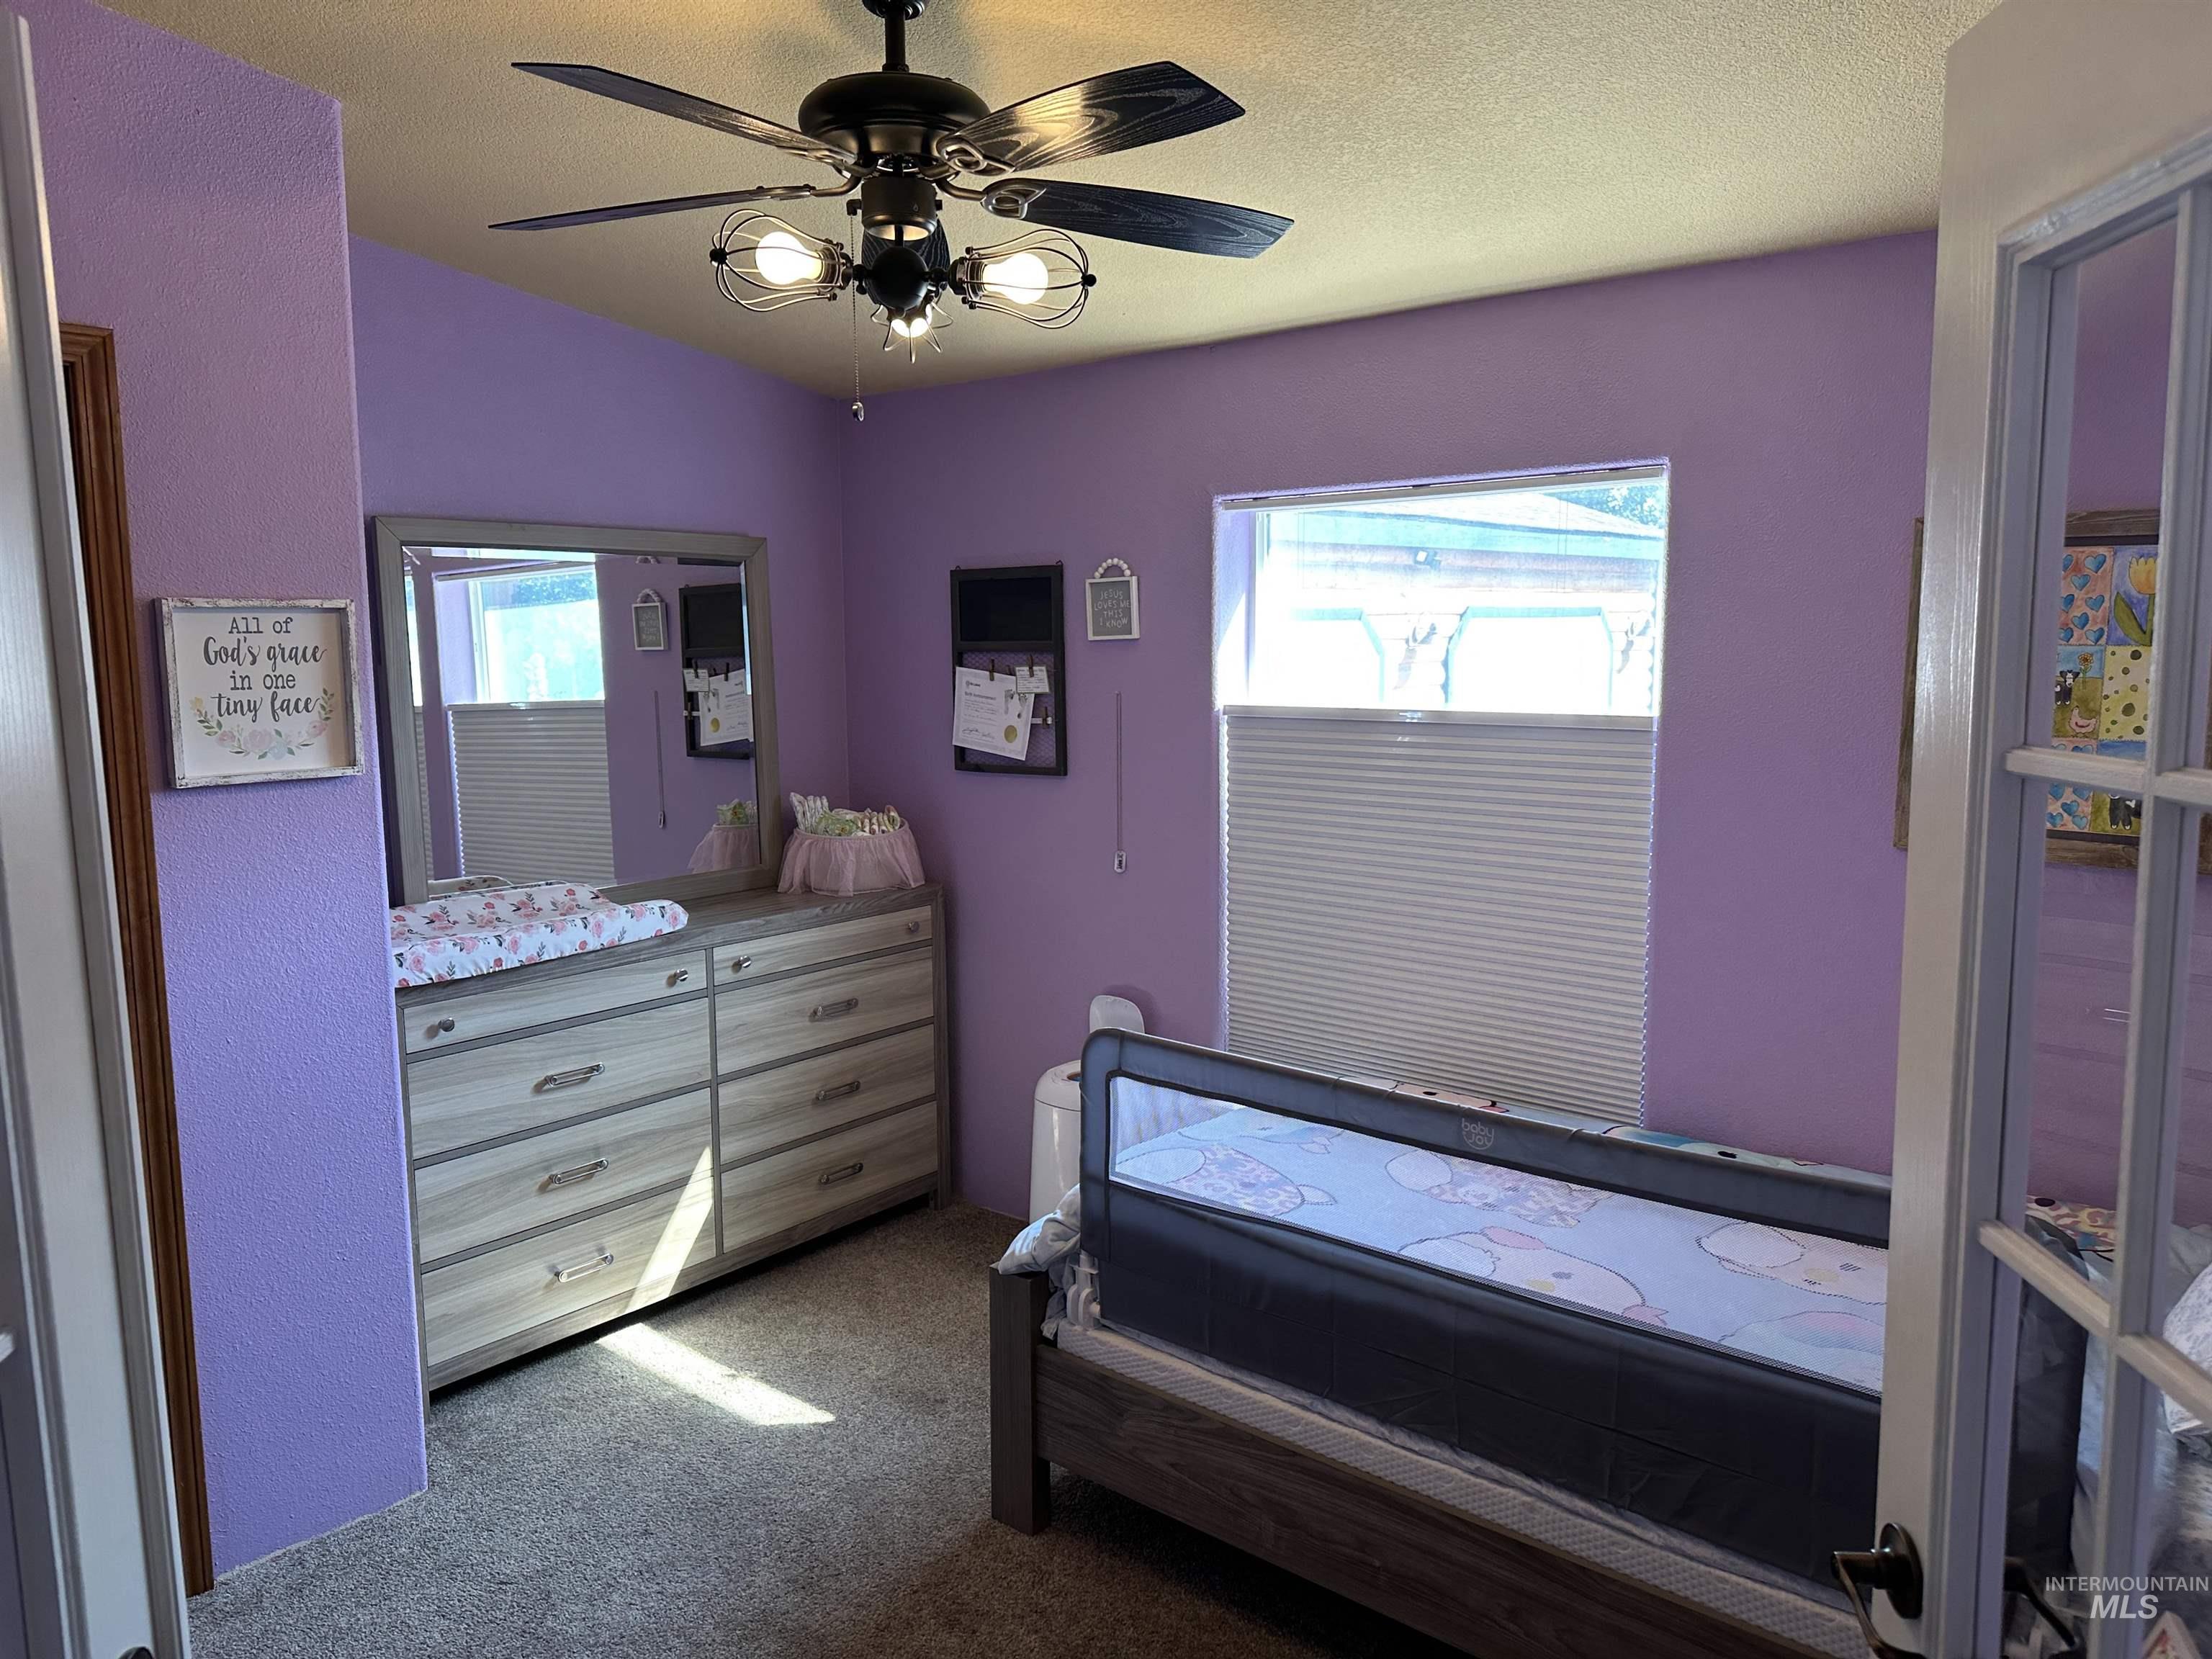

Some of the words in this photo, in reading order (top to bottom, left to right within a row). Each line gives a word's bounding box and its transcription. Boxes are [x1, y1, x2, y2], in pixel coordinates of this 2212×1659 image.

[1100, 589, 1123, 600] JESUS
[1094, 599, 1118, 611] LOVES
[1103, 609, 1123, 618] THIS
[228, 617, 264, 634] All
[272, 616, 293, 634] of
[1106, 617, 1128, 629] KNOW
[203, 636, 261, 666] God's
[266, 643, 328, 672] grace
[230, 670, 252, 691] in
[263, 673, 296, 689] one
[210, 693, 263, 723] tiny
[270, 691, 320, 722] face
[1462, 1118, 1494, 1137] baby
